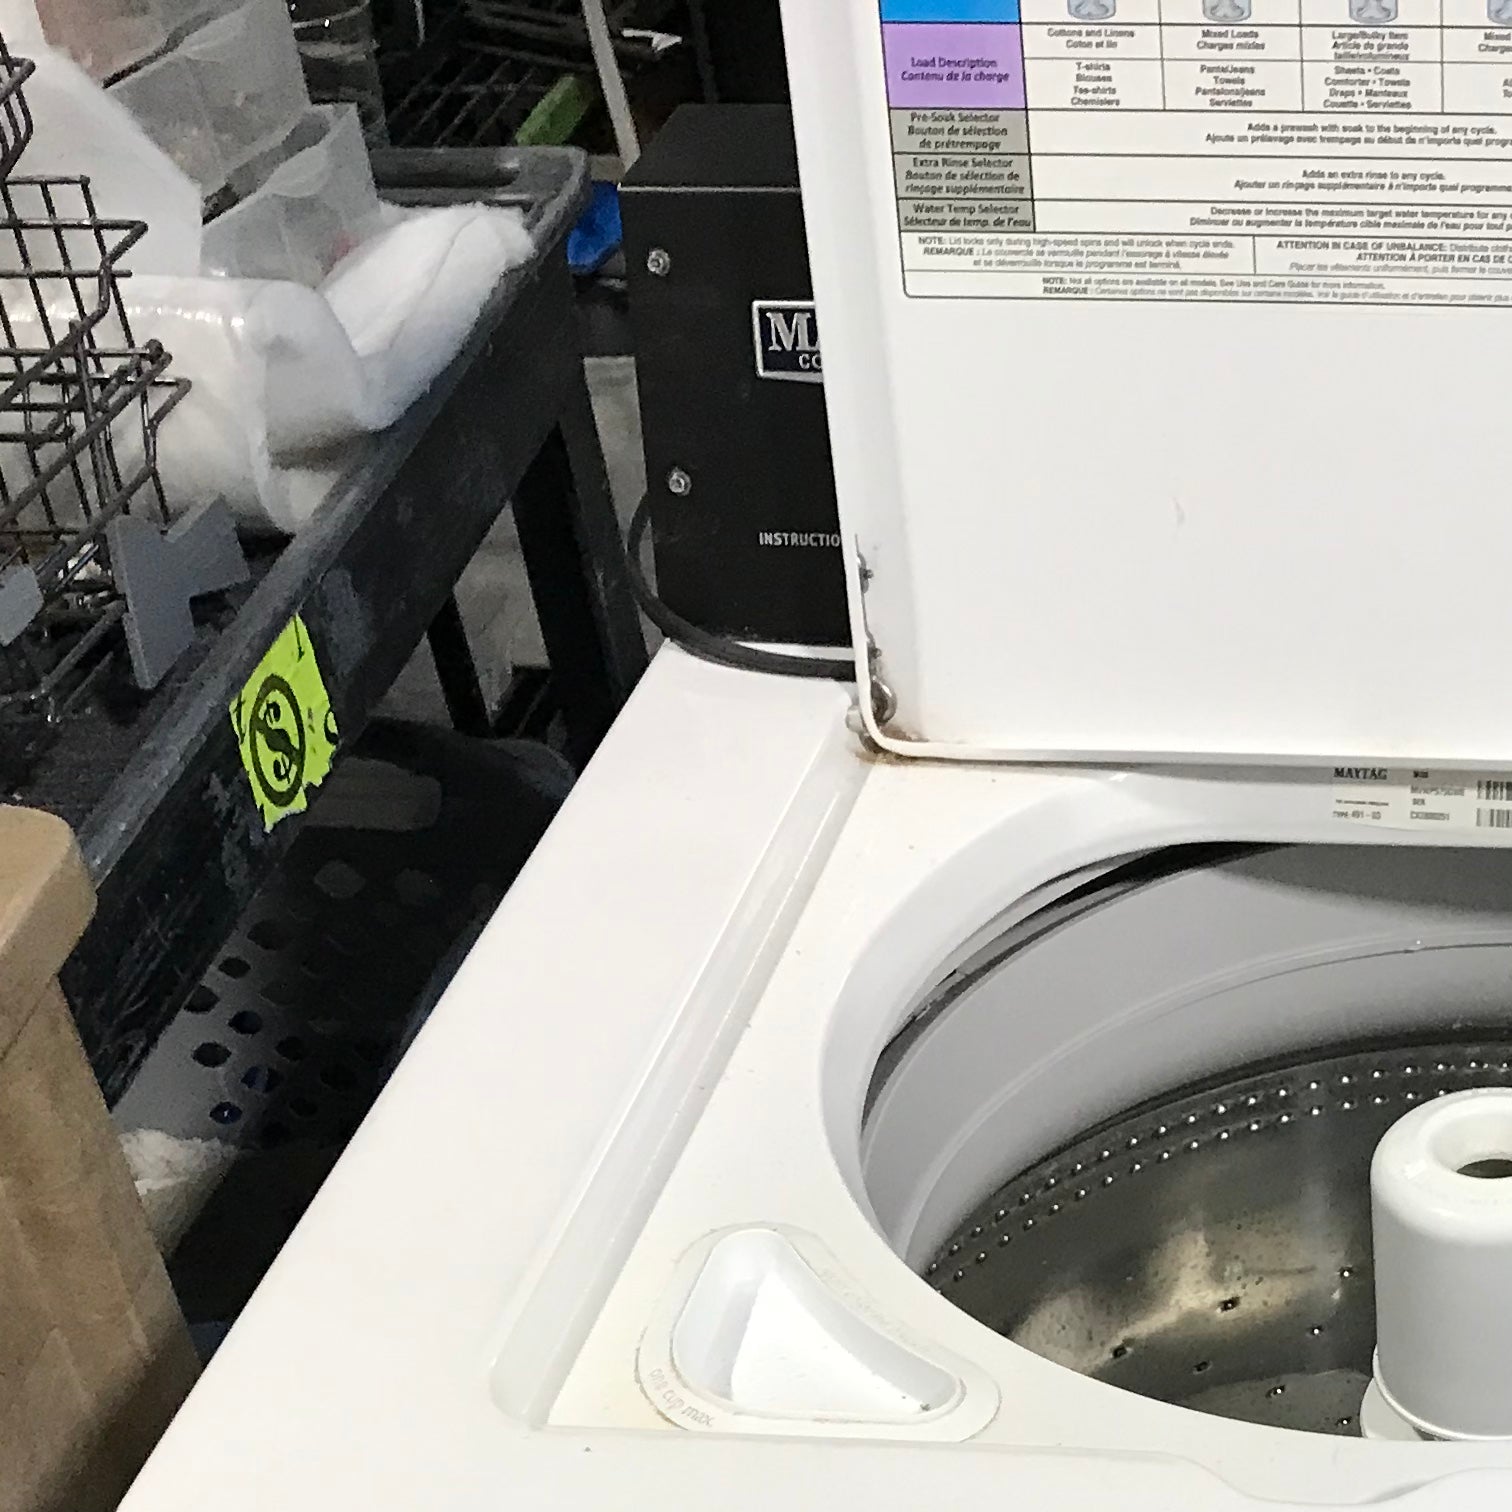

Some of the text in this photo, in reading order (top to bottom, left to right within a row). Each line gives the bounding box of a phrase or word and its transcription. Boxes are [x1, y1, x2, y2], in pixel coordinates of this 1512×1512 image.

[910, 57, 997, 70] Load Description
[766, 312, 820, 351] M
[1333, 767, 1388, 780] MAYTAG
